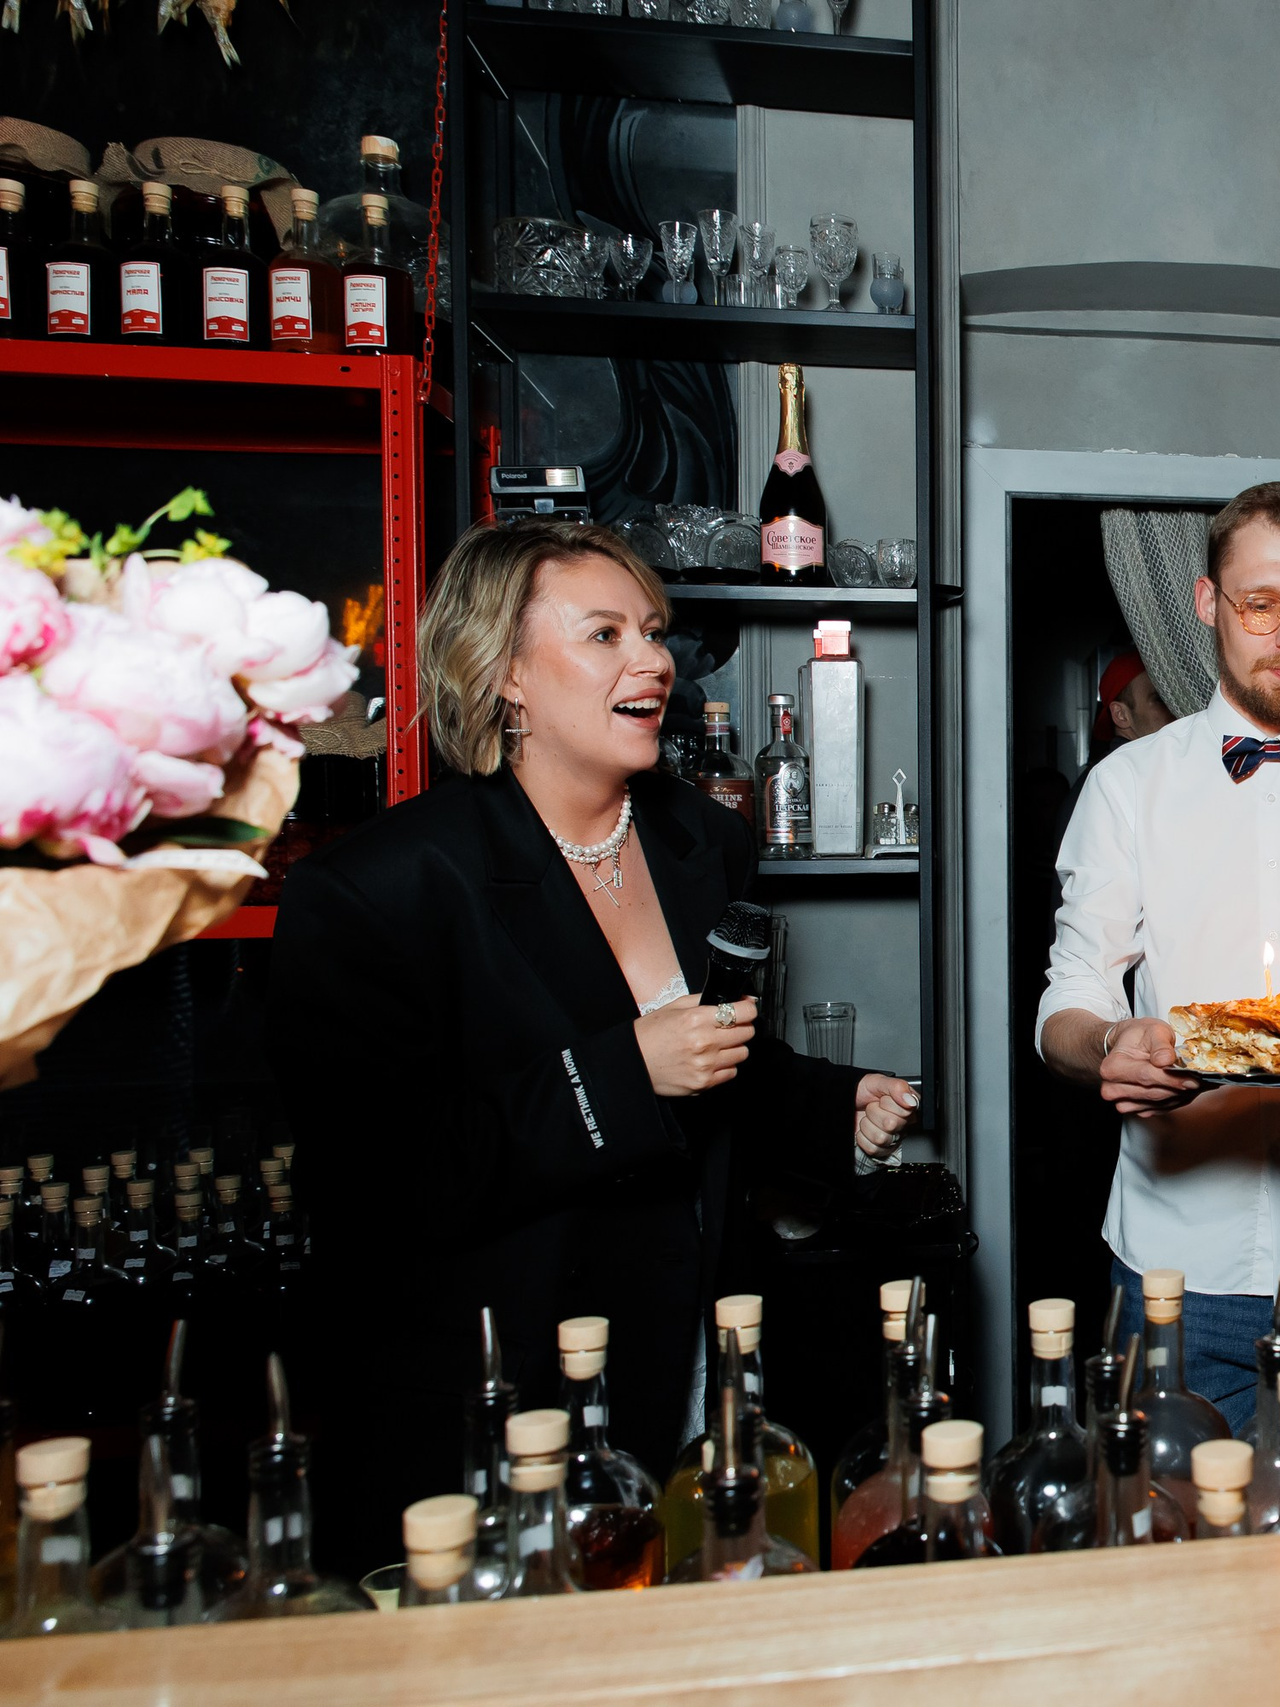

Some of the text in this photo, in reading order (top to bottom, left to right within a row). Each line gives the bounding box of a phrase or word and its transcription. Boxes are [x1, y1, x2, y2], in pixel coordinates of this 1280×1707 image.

[208, 296, 244, 305] АНИСОВКА
[275, 296, 302, 304] КИМЧИ
[501, 472, 528, 480] Polaroid
[561, 1048, 578, 1076] NORM
[570, 1074, 582, 1084] A
[590, 1130, 605, 1149] WE
